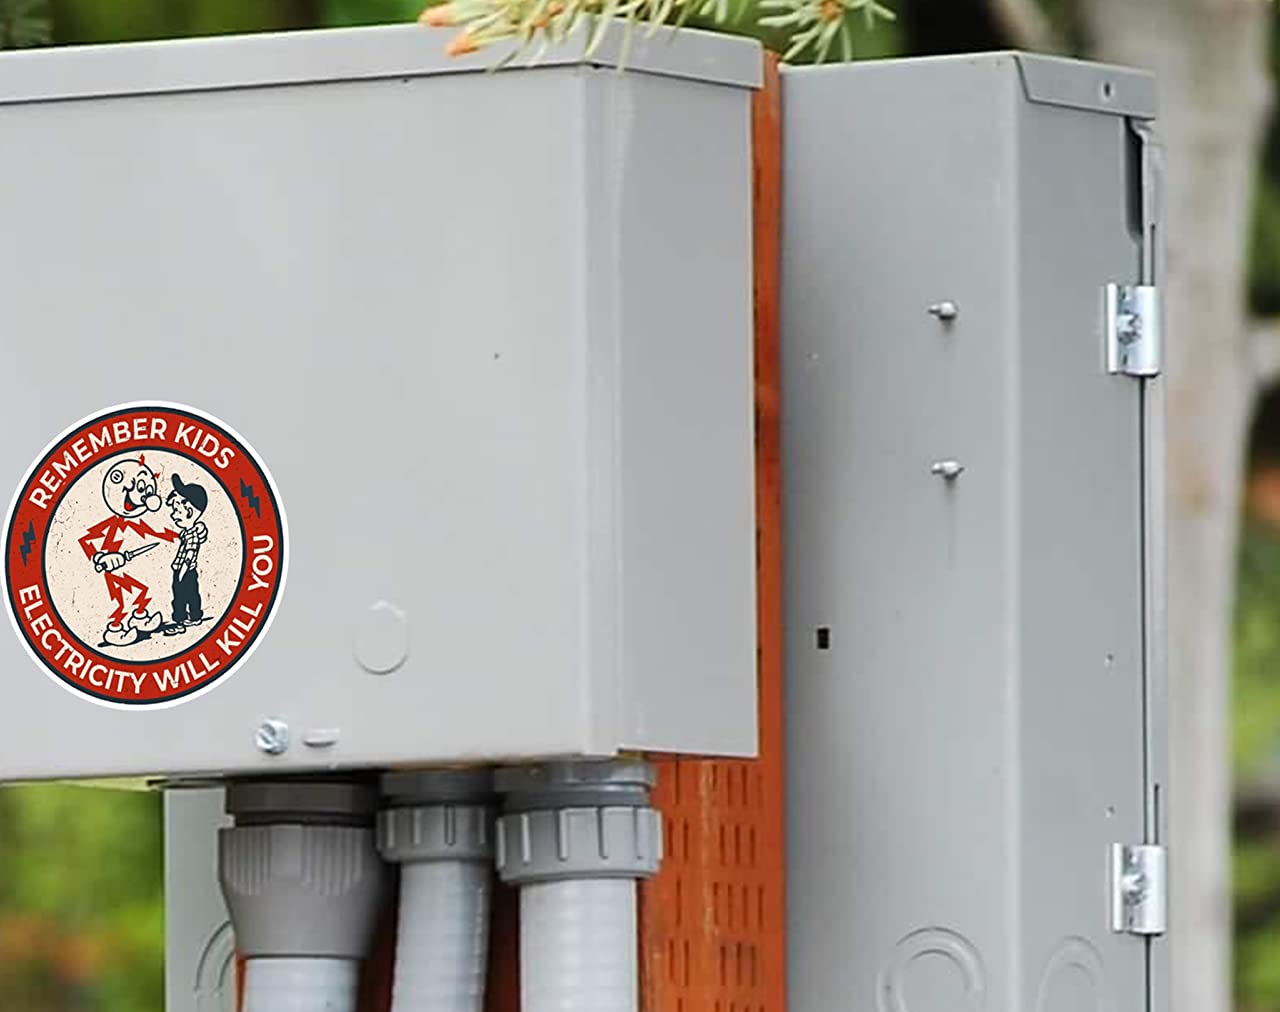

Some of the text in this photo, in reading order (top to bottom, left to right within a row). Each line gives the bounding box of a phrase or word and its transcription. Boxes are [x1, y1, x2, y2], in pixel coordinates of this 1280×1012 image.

[29, 418, 235, 509] REMEMBER KIDS
[19, 535, 275, 693] ELECTRICITY WILL KILL YOU
